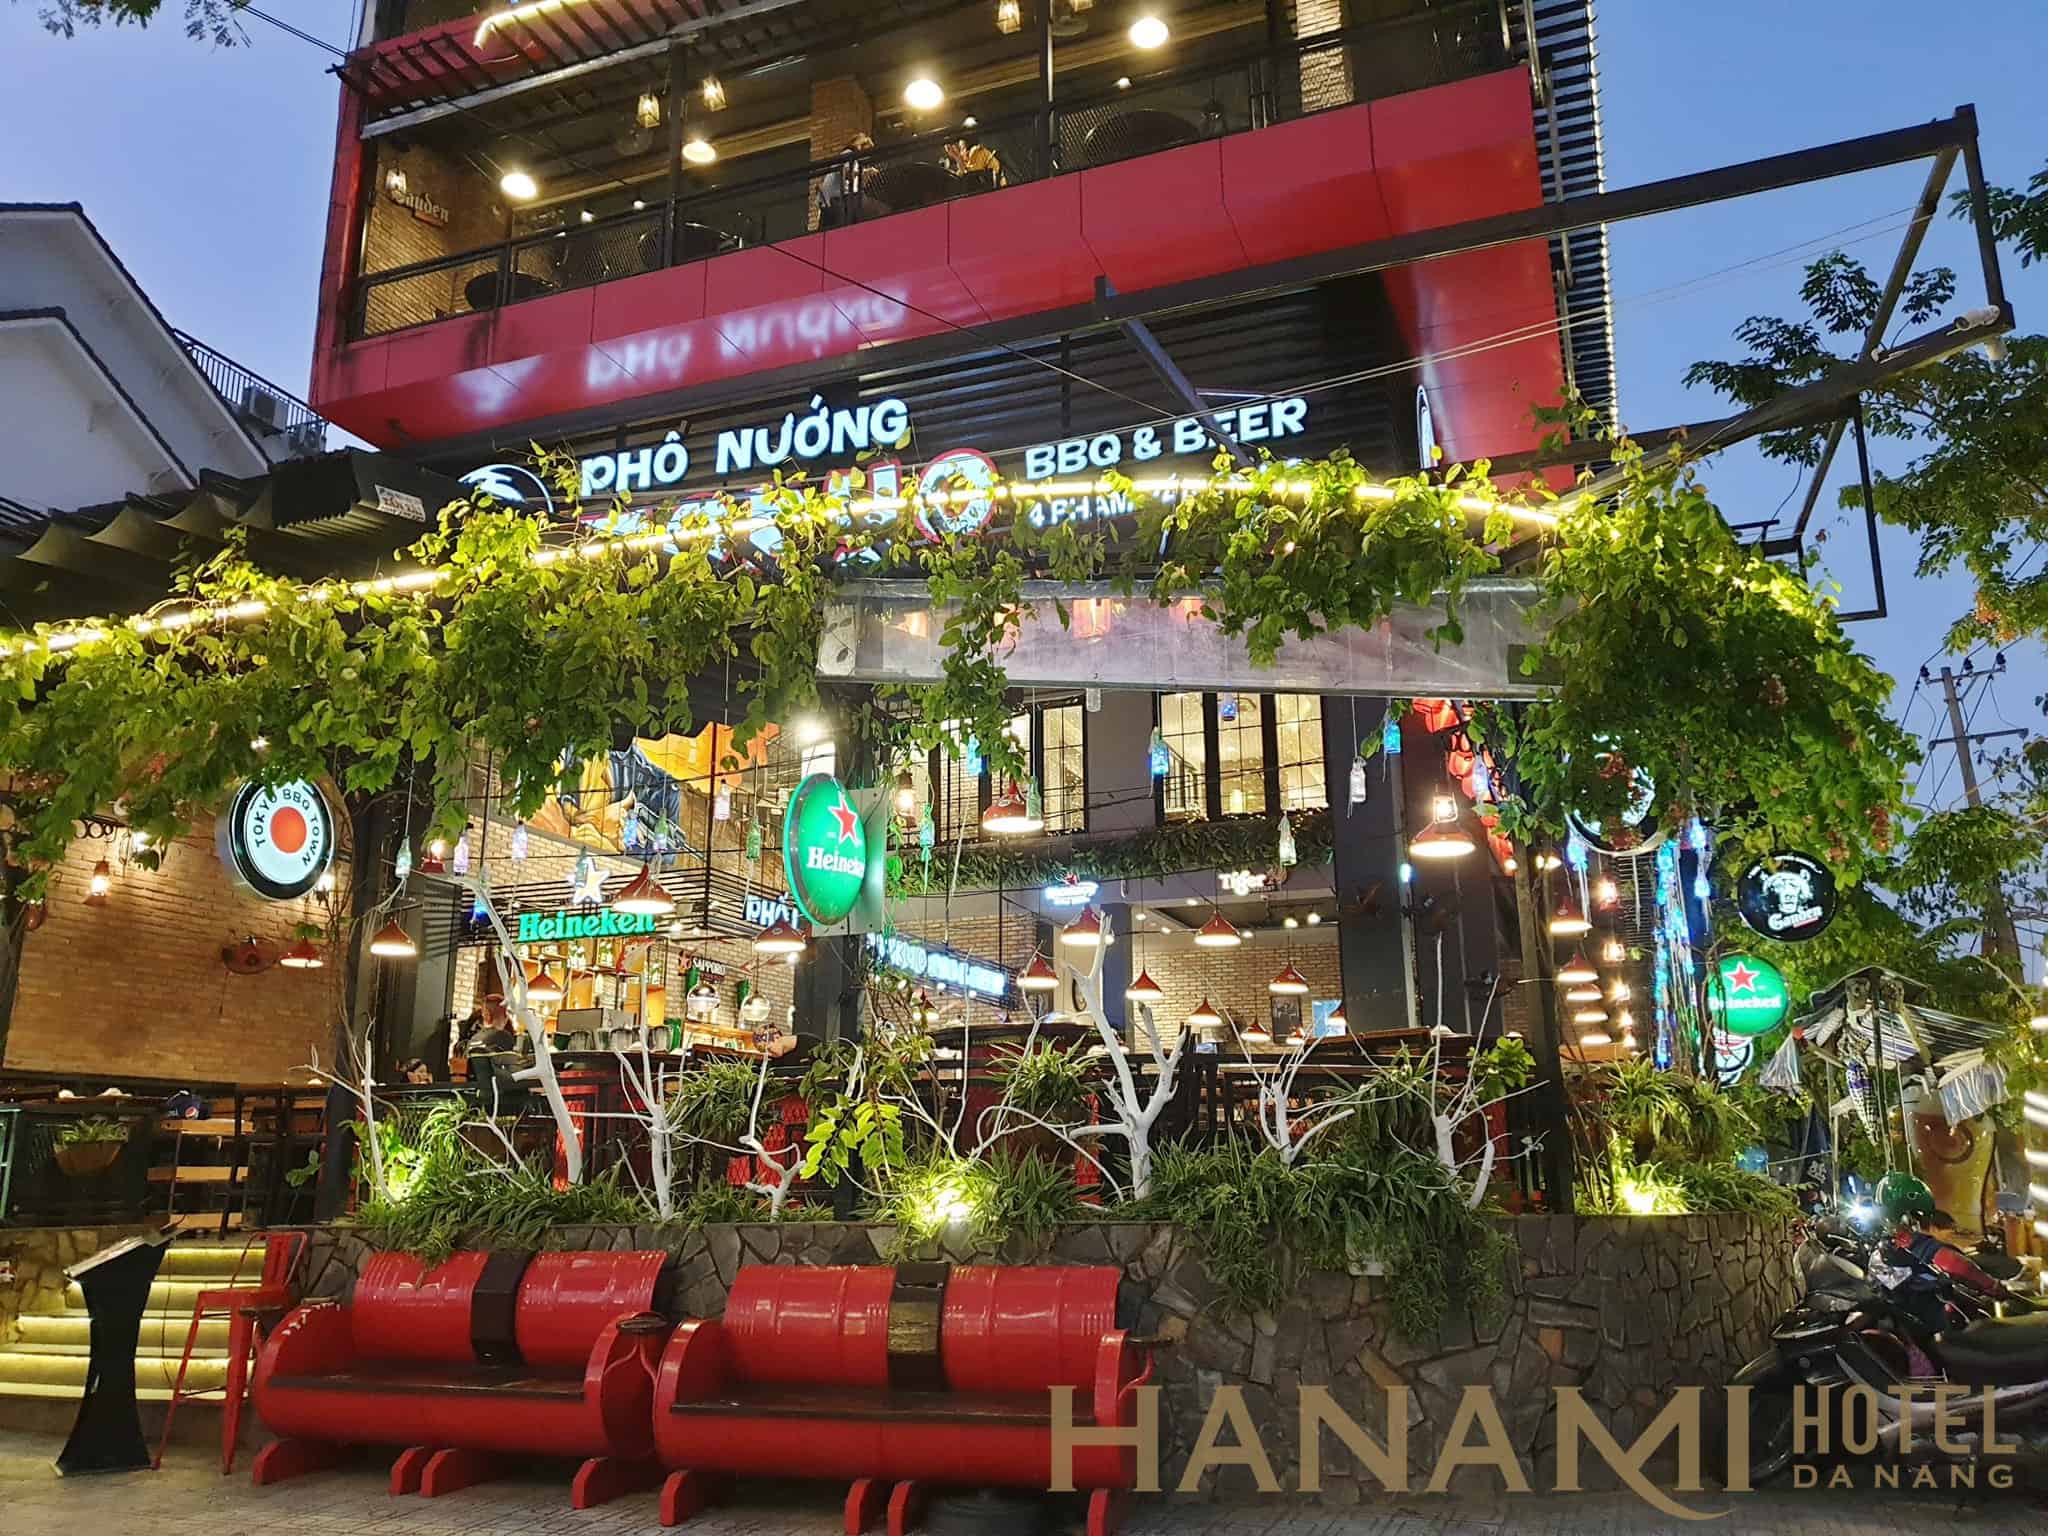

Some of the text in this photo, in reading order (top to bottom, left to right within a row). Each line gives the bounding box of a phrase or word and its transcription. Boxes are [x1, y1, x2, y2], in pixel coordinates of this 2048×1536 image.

[715, 394, 908, 473] NƯỚNG
[1025, 433, 1122, 481] BBQ
[1132, 426, 1162, 460] &
[1029, 502, 1046, 528] 4
[282, 788, 310, 811] BBQ
[302, 814, 319, 866] TOWN
[1218, 870, 1267, 896] Tiger
[517, 906, 657, 942] Heineken
